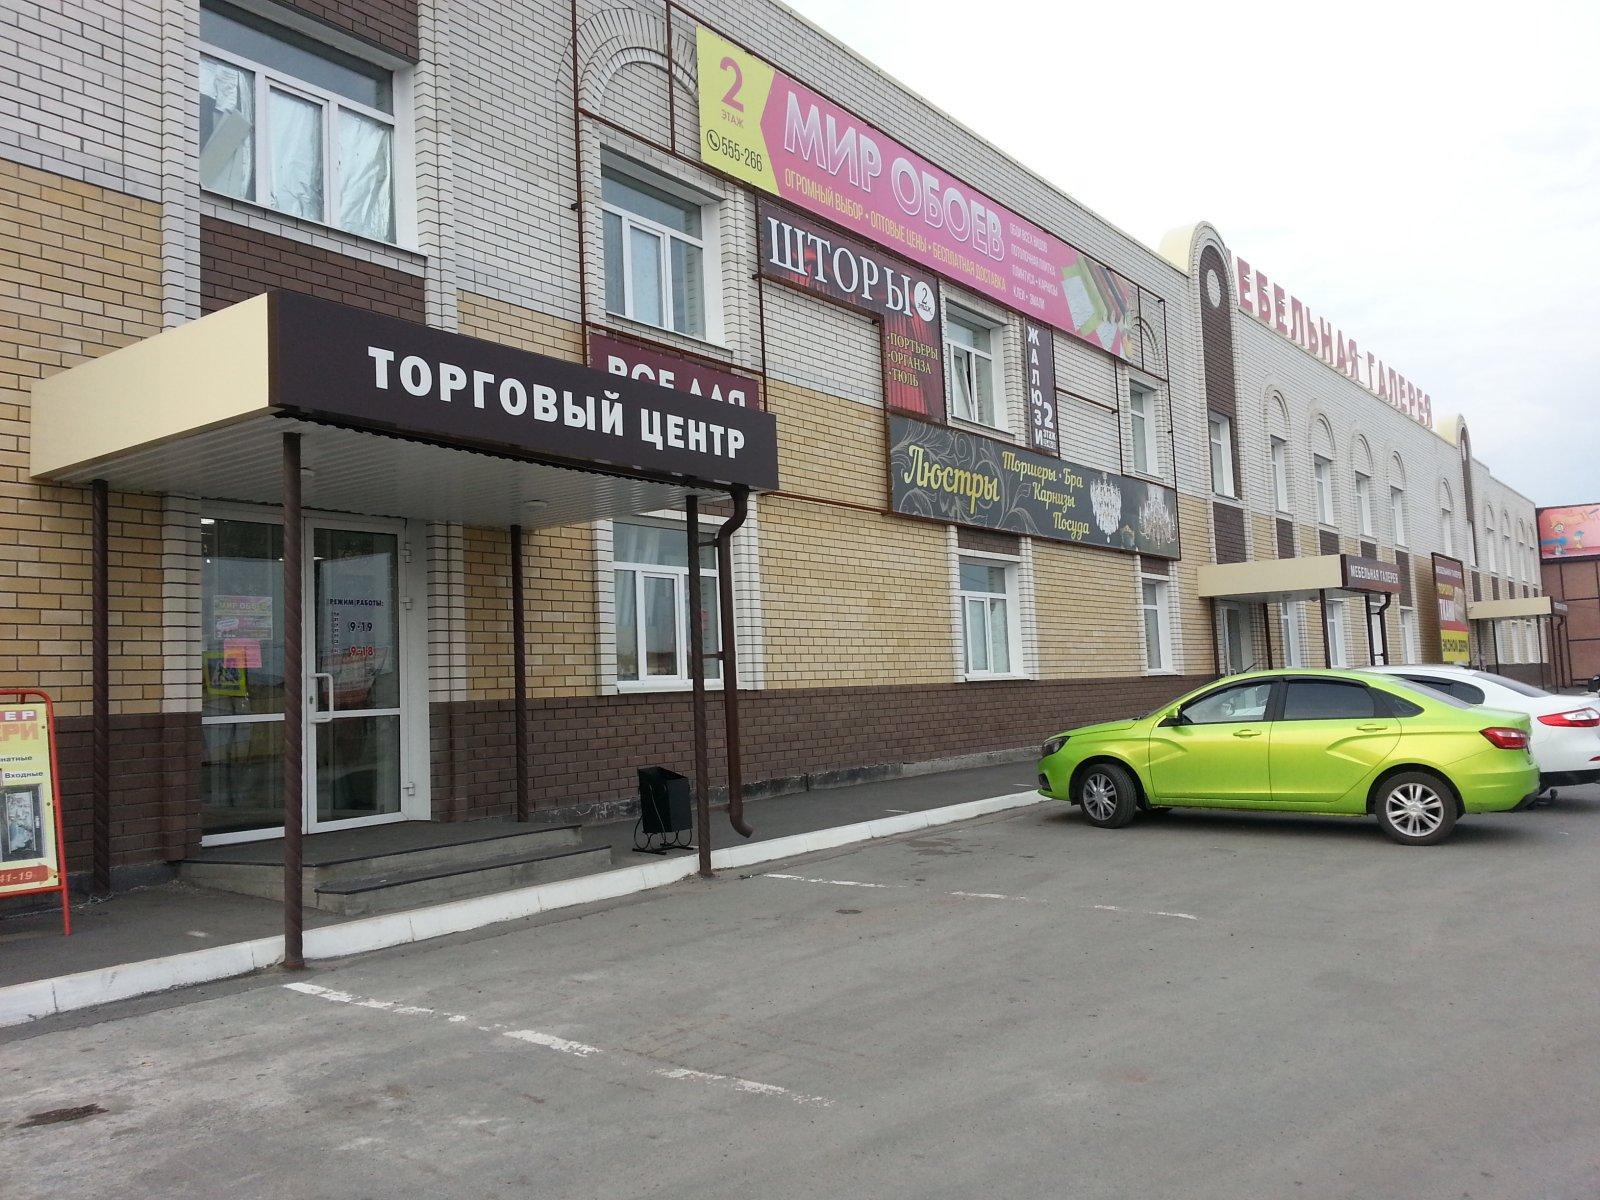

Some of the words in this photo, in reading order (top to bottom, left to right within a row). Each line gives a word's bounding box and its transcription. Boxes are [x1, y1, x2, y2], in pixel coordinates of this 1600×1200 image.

[720, 56, 744, 112] 2
[721, 109, 744, 128] ЭТАЖ
[721, 136, 763, 172] 555-266
[784, 91, 882, 193] МИР
[891, 157, 1004, 262] ОБОЕВ
[785, 168, 834, 208] ОГРОМНЫЙ
[835, 192, 863, 221] ВЫБОР
[870, 210, 905, 243] ОПТОВЫЕ
[907, 228, 926, 255] ЦЕНЫ
[932, 239, 976, 277] БЕСПЛАТНАЯ
[975, 261, 1006, 293] ДОСТАВКА
[767, 217, 914, 317] ШТОРЫ
[921, 287, 928, 305] 2
[891, 332, 939, 361] ПОРТЬЕРЫ
[1226, 248, 1361, 382] ЕБЕЛЬНАЯ
[1367, 351, 1432, 428] ГАЛЕРЕЯ
[891, 350, 932, 374] ОРГАНЗА
[892, 367, 919, 387] ТЮЛЬ
[367, 346, 624, 437] ТОРГОВЫЙ
[640, 407, 745, 459] ЦЕНТР
[1043, 401, 1054, 429] 2
[904, 444, 1000, 515] Люстры
[1002, 451, 1057, 483] Торшеры
[1062, 467, 1084, 490] Бра
[1032, 482, 1076, 513] Карнизы
[1053, 511, 1090, 541] Посуда
